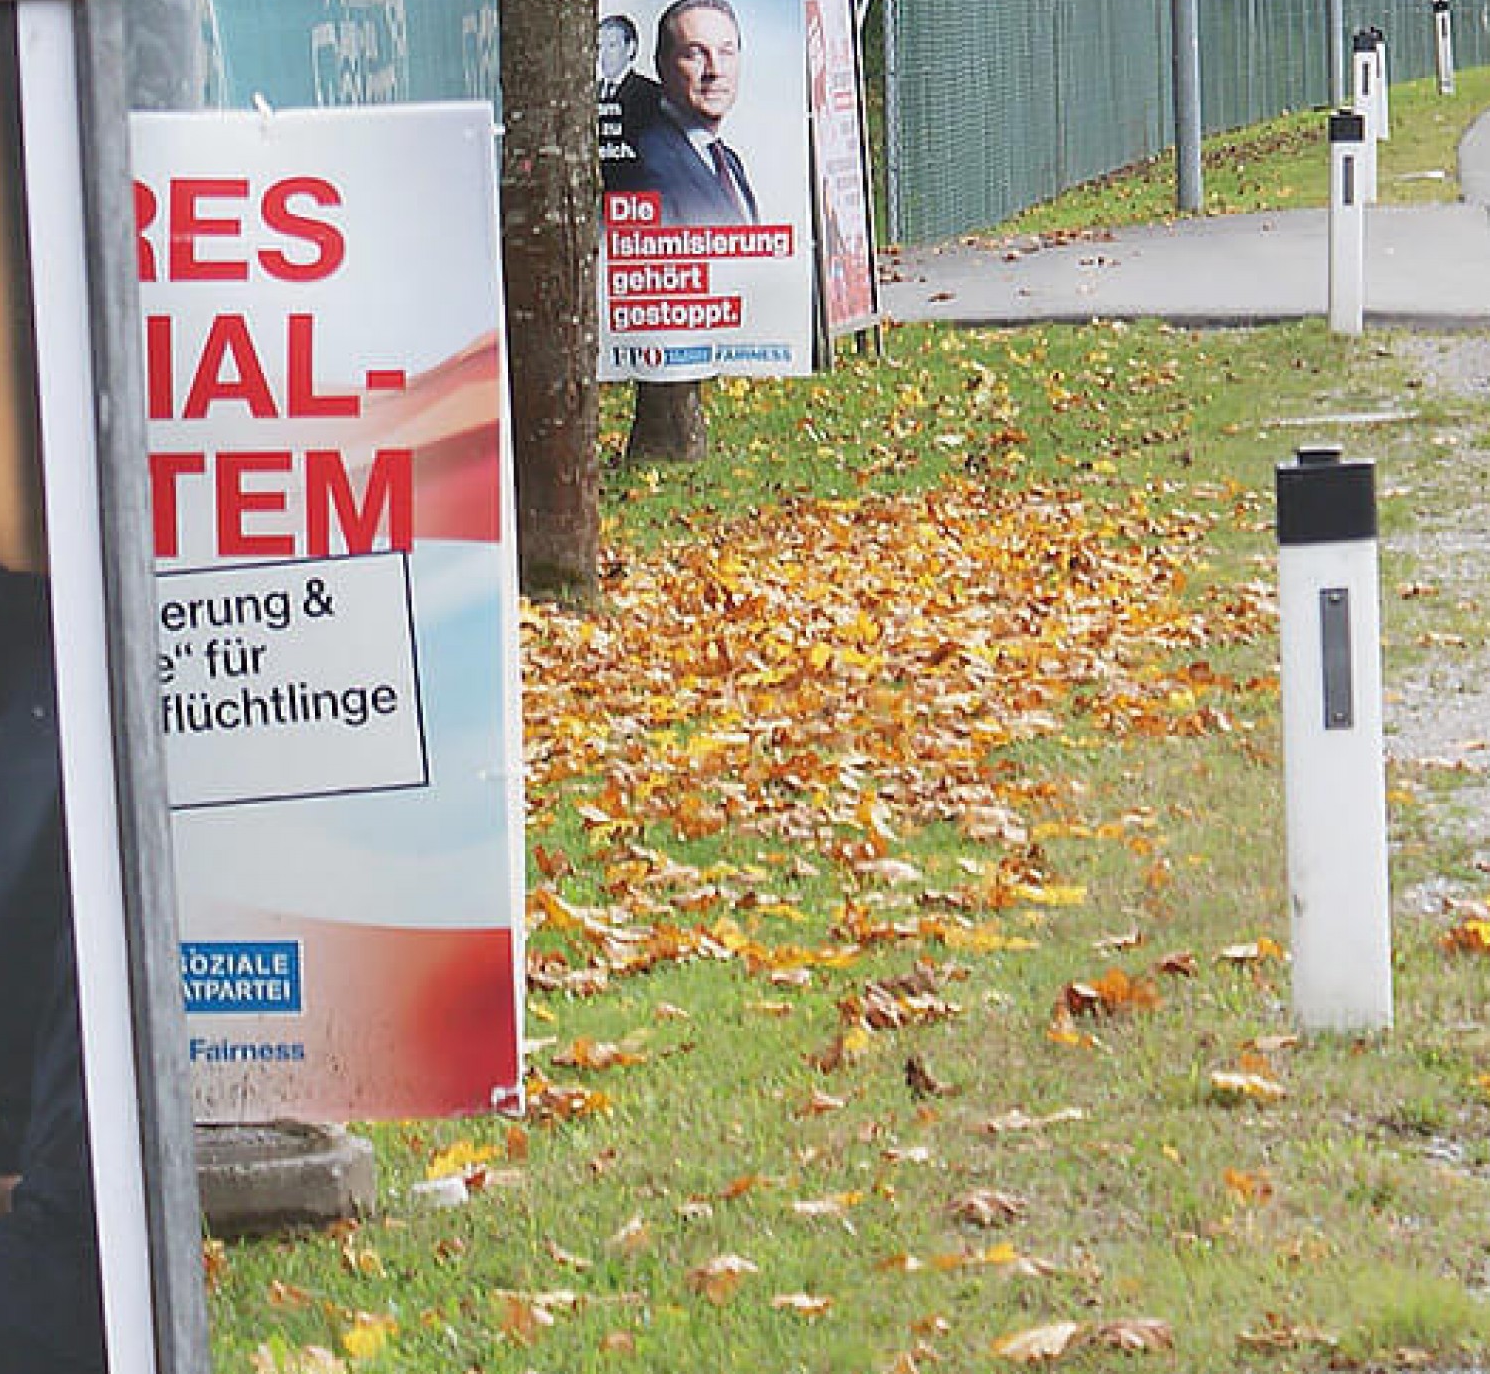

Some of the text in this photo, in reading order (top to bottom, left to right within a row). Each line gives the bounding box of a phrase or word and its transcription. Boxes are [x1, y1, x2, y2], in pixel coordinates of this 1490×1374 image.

[611, 196, 654, 221] Die
[612, 229, 788, 257] Islamisierung
[612, 265, 702, 296] gehört
[614, 301, 738, 329] gestoppt.
[147, 313, 406, 419] IAL-
[148, 449, 413, 557] TEM
[161, 577, 335, 631] erung &
[205, 638, 267, 677] für
[162, 682, 397, 734] flüchtlinge
[189, 1038, 305, 1063] Fairness
